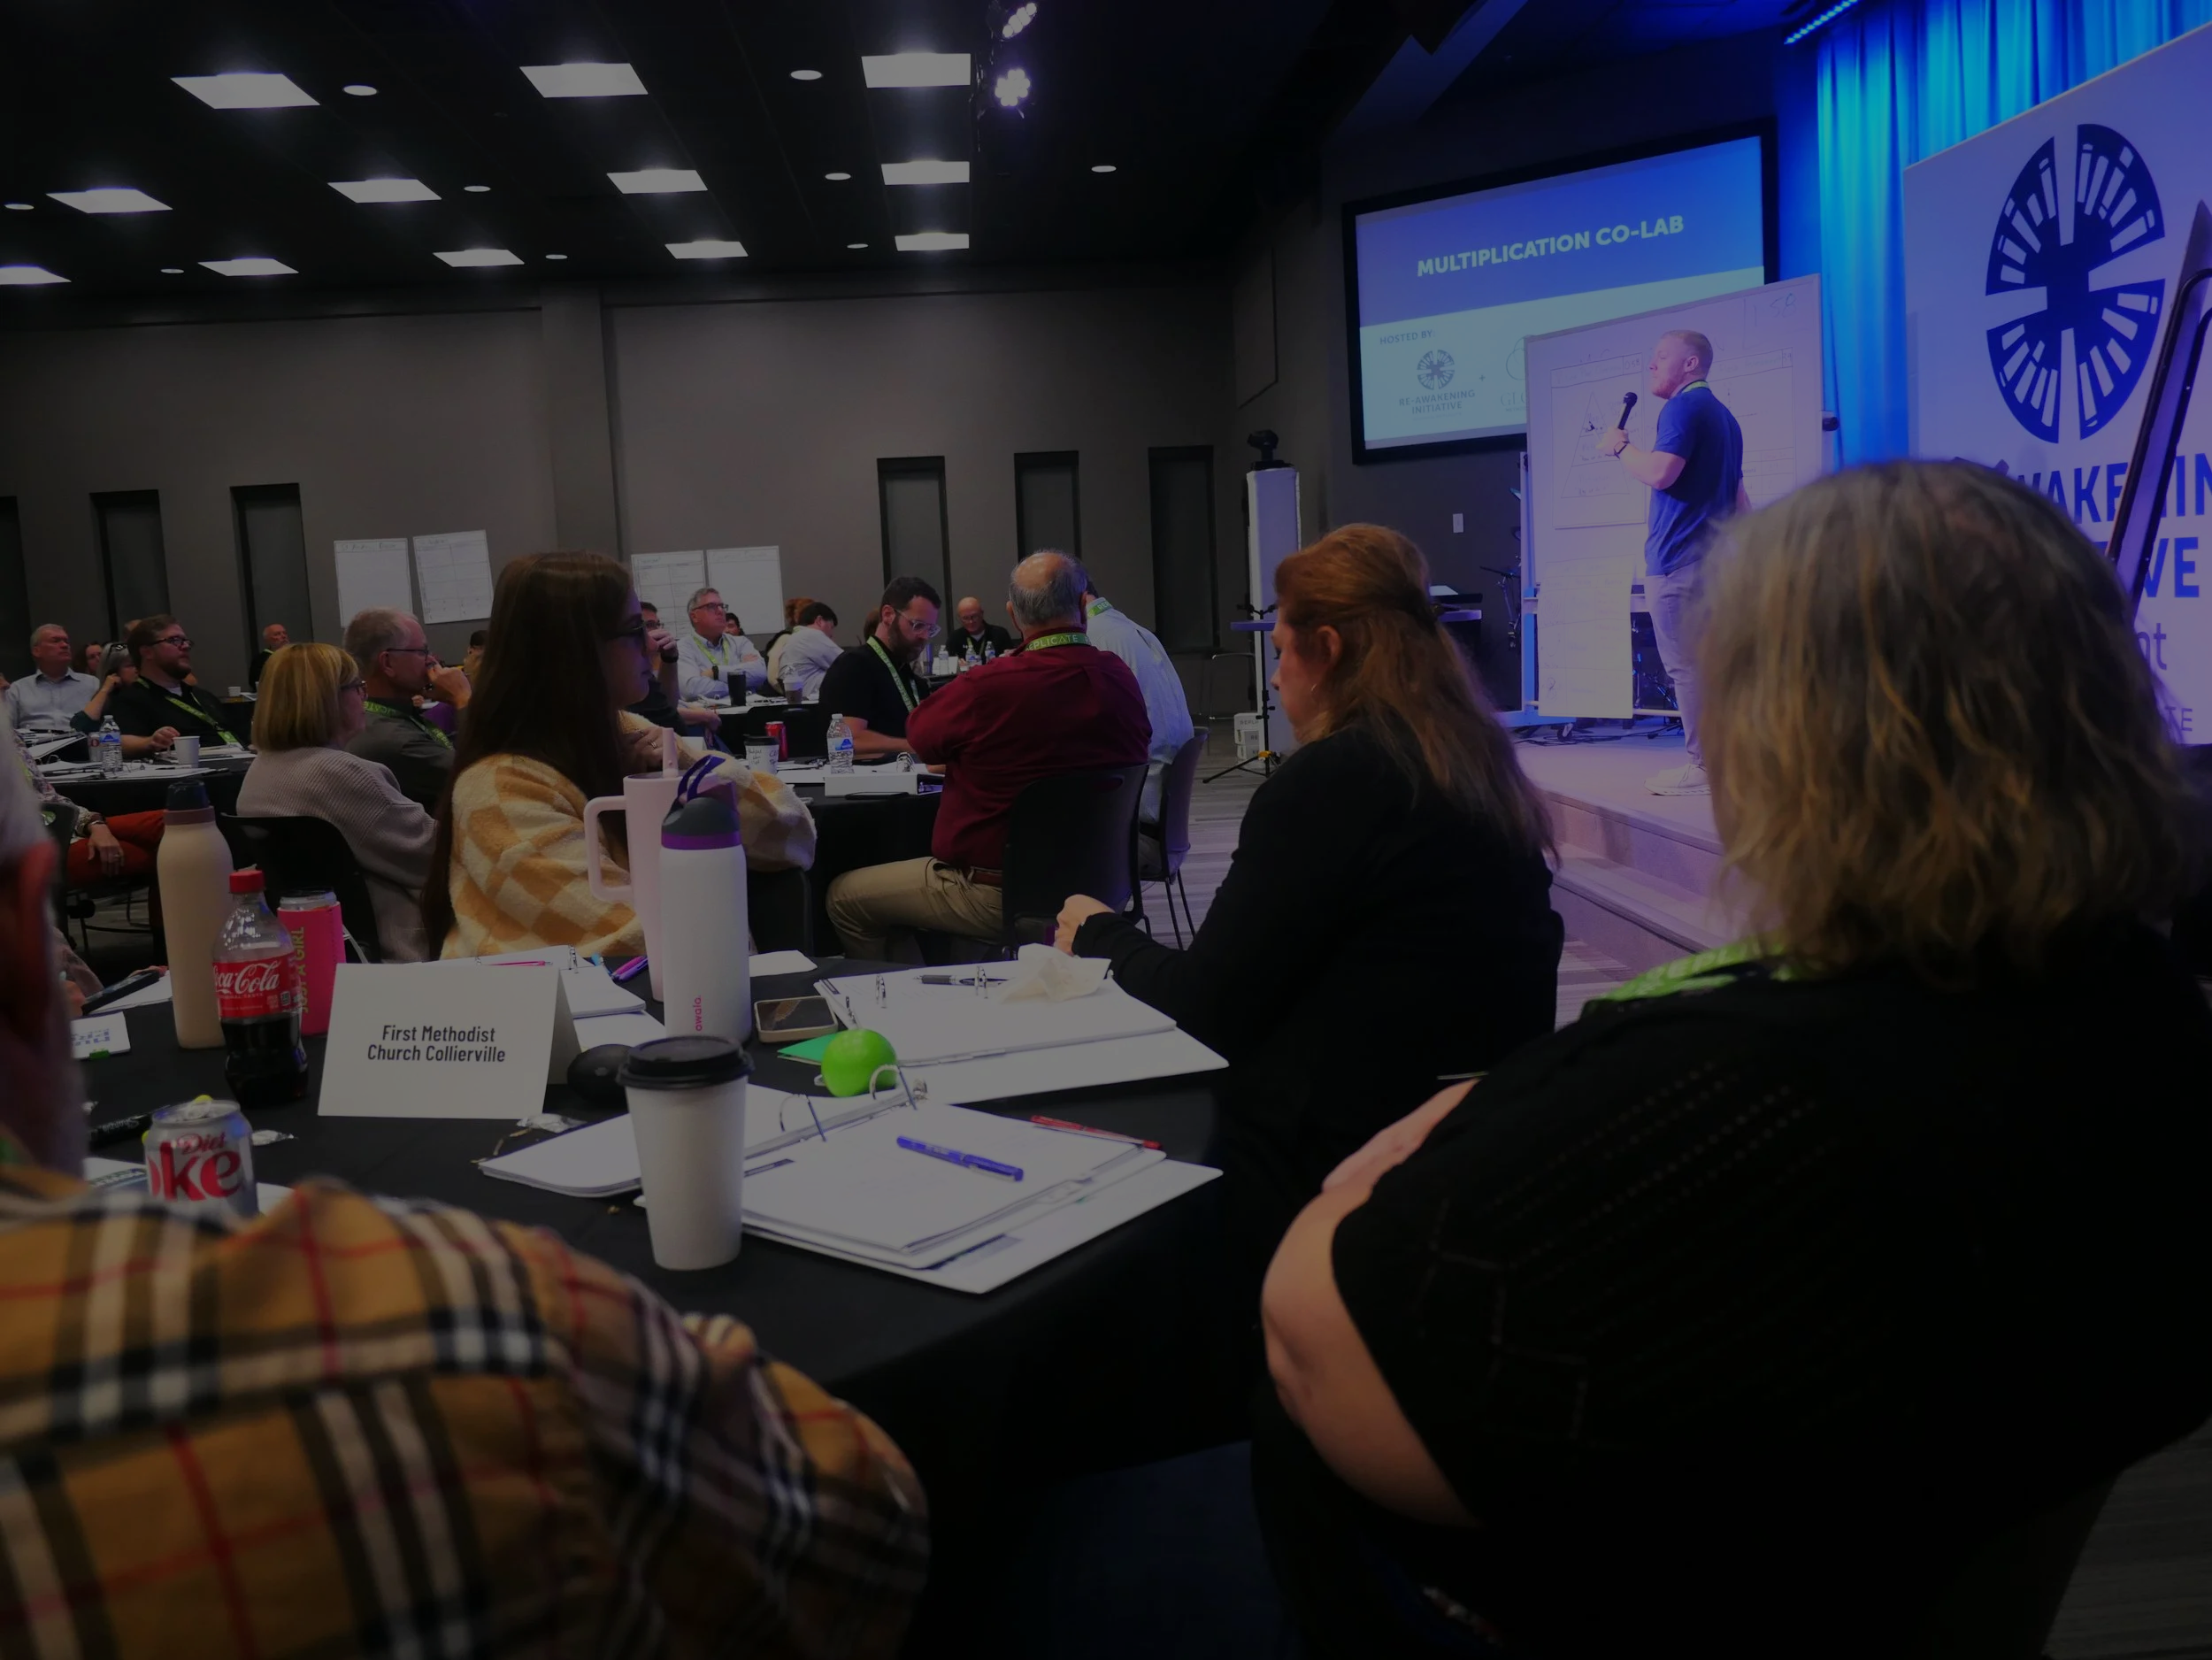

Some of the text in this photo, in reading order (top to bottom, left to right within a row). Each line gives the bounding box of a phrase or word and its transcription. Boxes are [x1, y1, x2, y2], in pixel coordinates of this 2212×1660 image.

[1417, 215, 1684, 277] MULTIPLICATION CO-LAB
[1379, 332, 1418, 345] HOSTED
[1399, 389, 1476, 406] RE-AWAKENING
[1412, 401, 1463, 415] INITIATIVE
[291, 926, 305, 961] GIRL
[298, 965, 307, 976] A
[693, 997, 703, 1032] owala
[382, 1025, 495, 1042] First Methodist
[367, 1044, 506, 1062] Church Collierville
[176, 1132, 227, 1155] Diet
